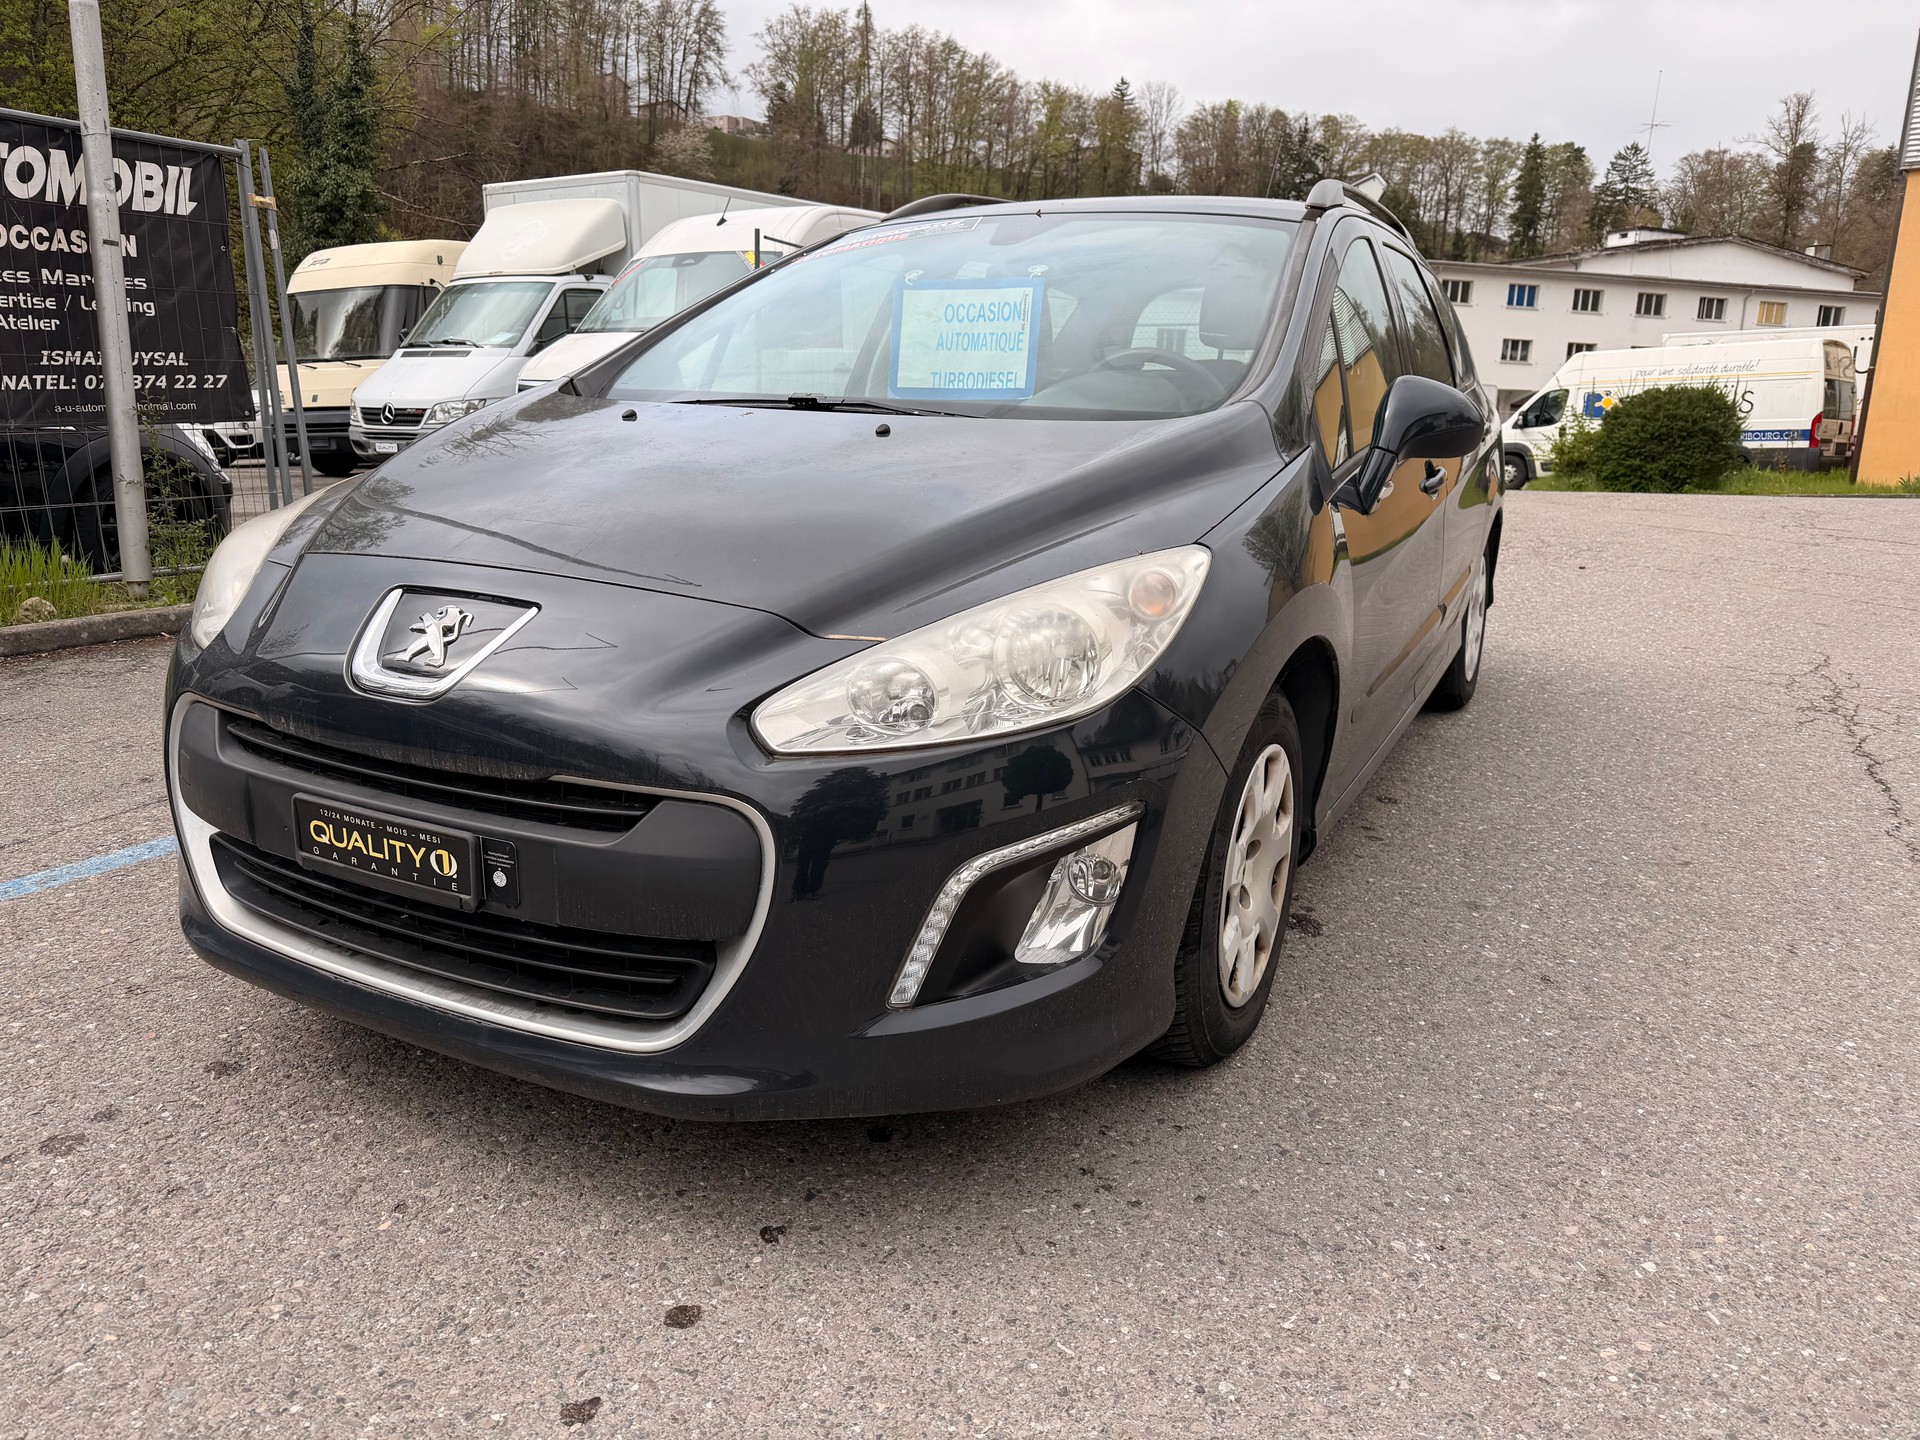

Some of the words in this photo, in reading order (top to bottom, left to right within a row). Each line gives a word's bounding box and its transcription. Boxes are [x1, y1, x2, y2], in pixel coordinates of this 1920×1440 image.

[944, 301, 1022, 324] OCCASION
[936, 331, 1025, 353] AUTOMATIQUE
[1, 374, 77, 391] NATEL:
[173, 374, 198, 389] 22
[203, 374, 229, 389] 27
[1635, 368, 1658, 378] pour
[1659, 367, 1675, 376] une
[319, 808, 341, 820] 12/24
[343, 814, 376, 829] MONATE
[386, 825, 408, 837] MOIS
[419, 833, 441, 844] MESI
[310, 820, 427, 868] QUALITY
[312, 846, 458, 892] GARANTIE
